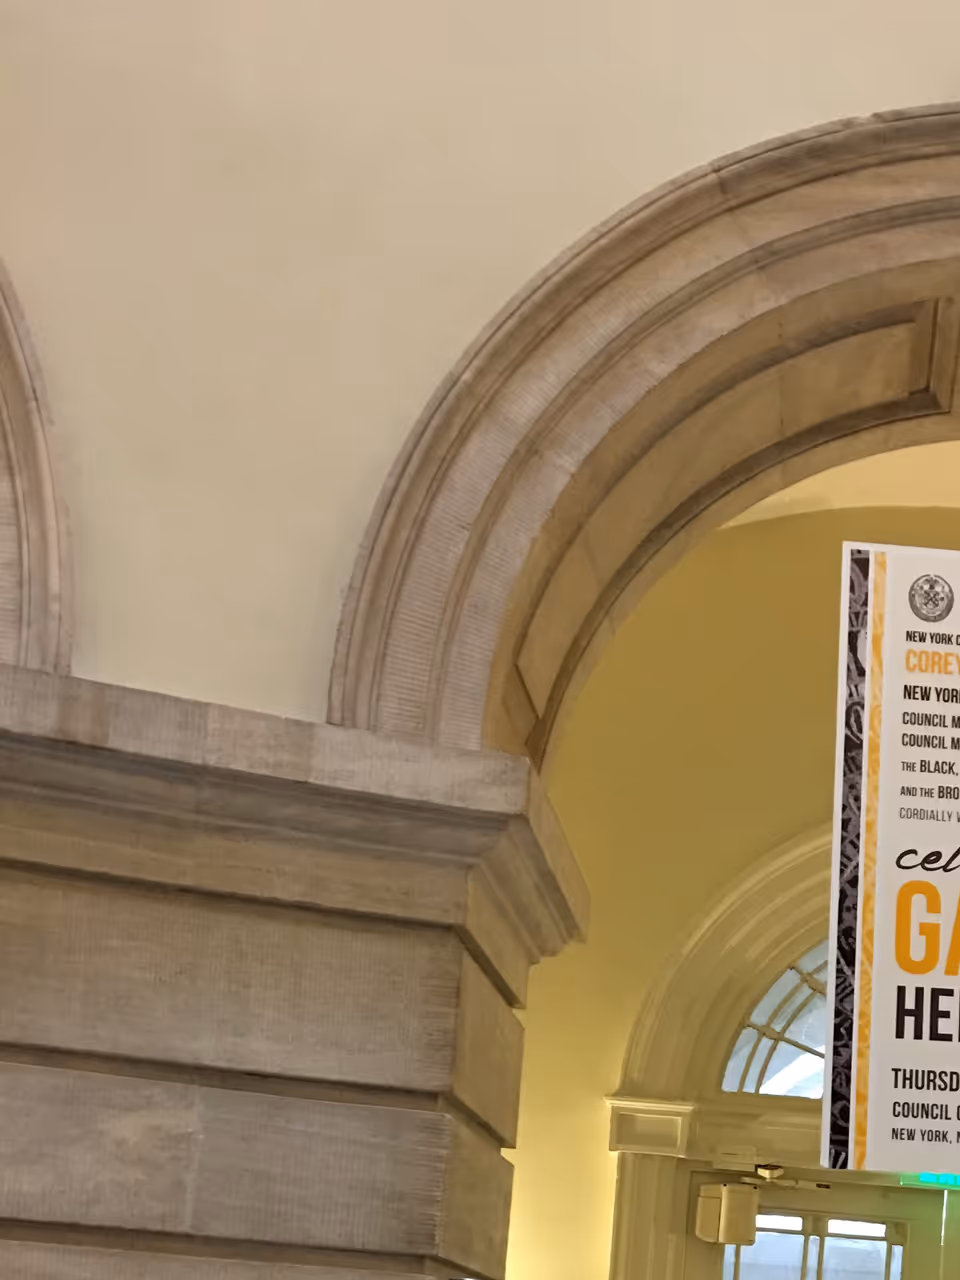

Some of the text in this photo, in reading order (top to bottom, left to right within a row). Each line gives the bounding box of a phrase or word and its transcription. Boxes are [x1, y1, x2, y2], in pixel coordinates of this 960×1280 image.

[906, 630, 927, 643] NEW
[929, 632, 953, 645] YORK
[903, 684, 932, 701] NEW
[902, 712, 948, 728] COUNCIL
[902, 733, 948, 749] COUNCIL
[901, 761, 916, 772] THE
[920, 760, 958, 776] BLACK,
[900, 786, 917, 796] AND
[920, 787, 935, 798] THE
[900, 807, 952, 822] CORDIALLY
[893, 1101, 952, 1120] COUNCIL
[892, 1128, 916, 1141] NEW
[920, 1129, 952, 1144] YORK,
